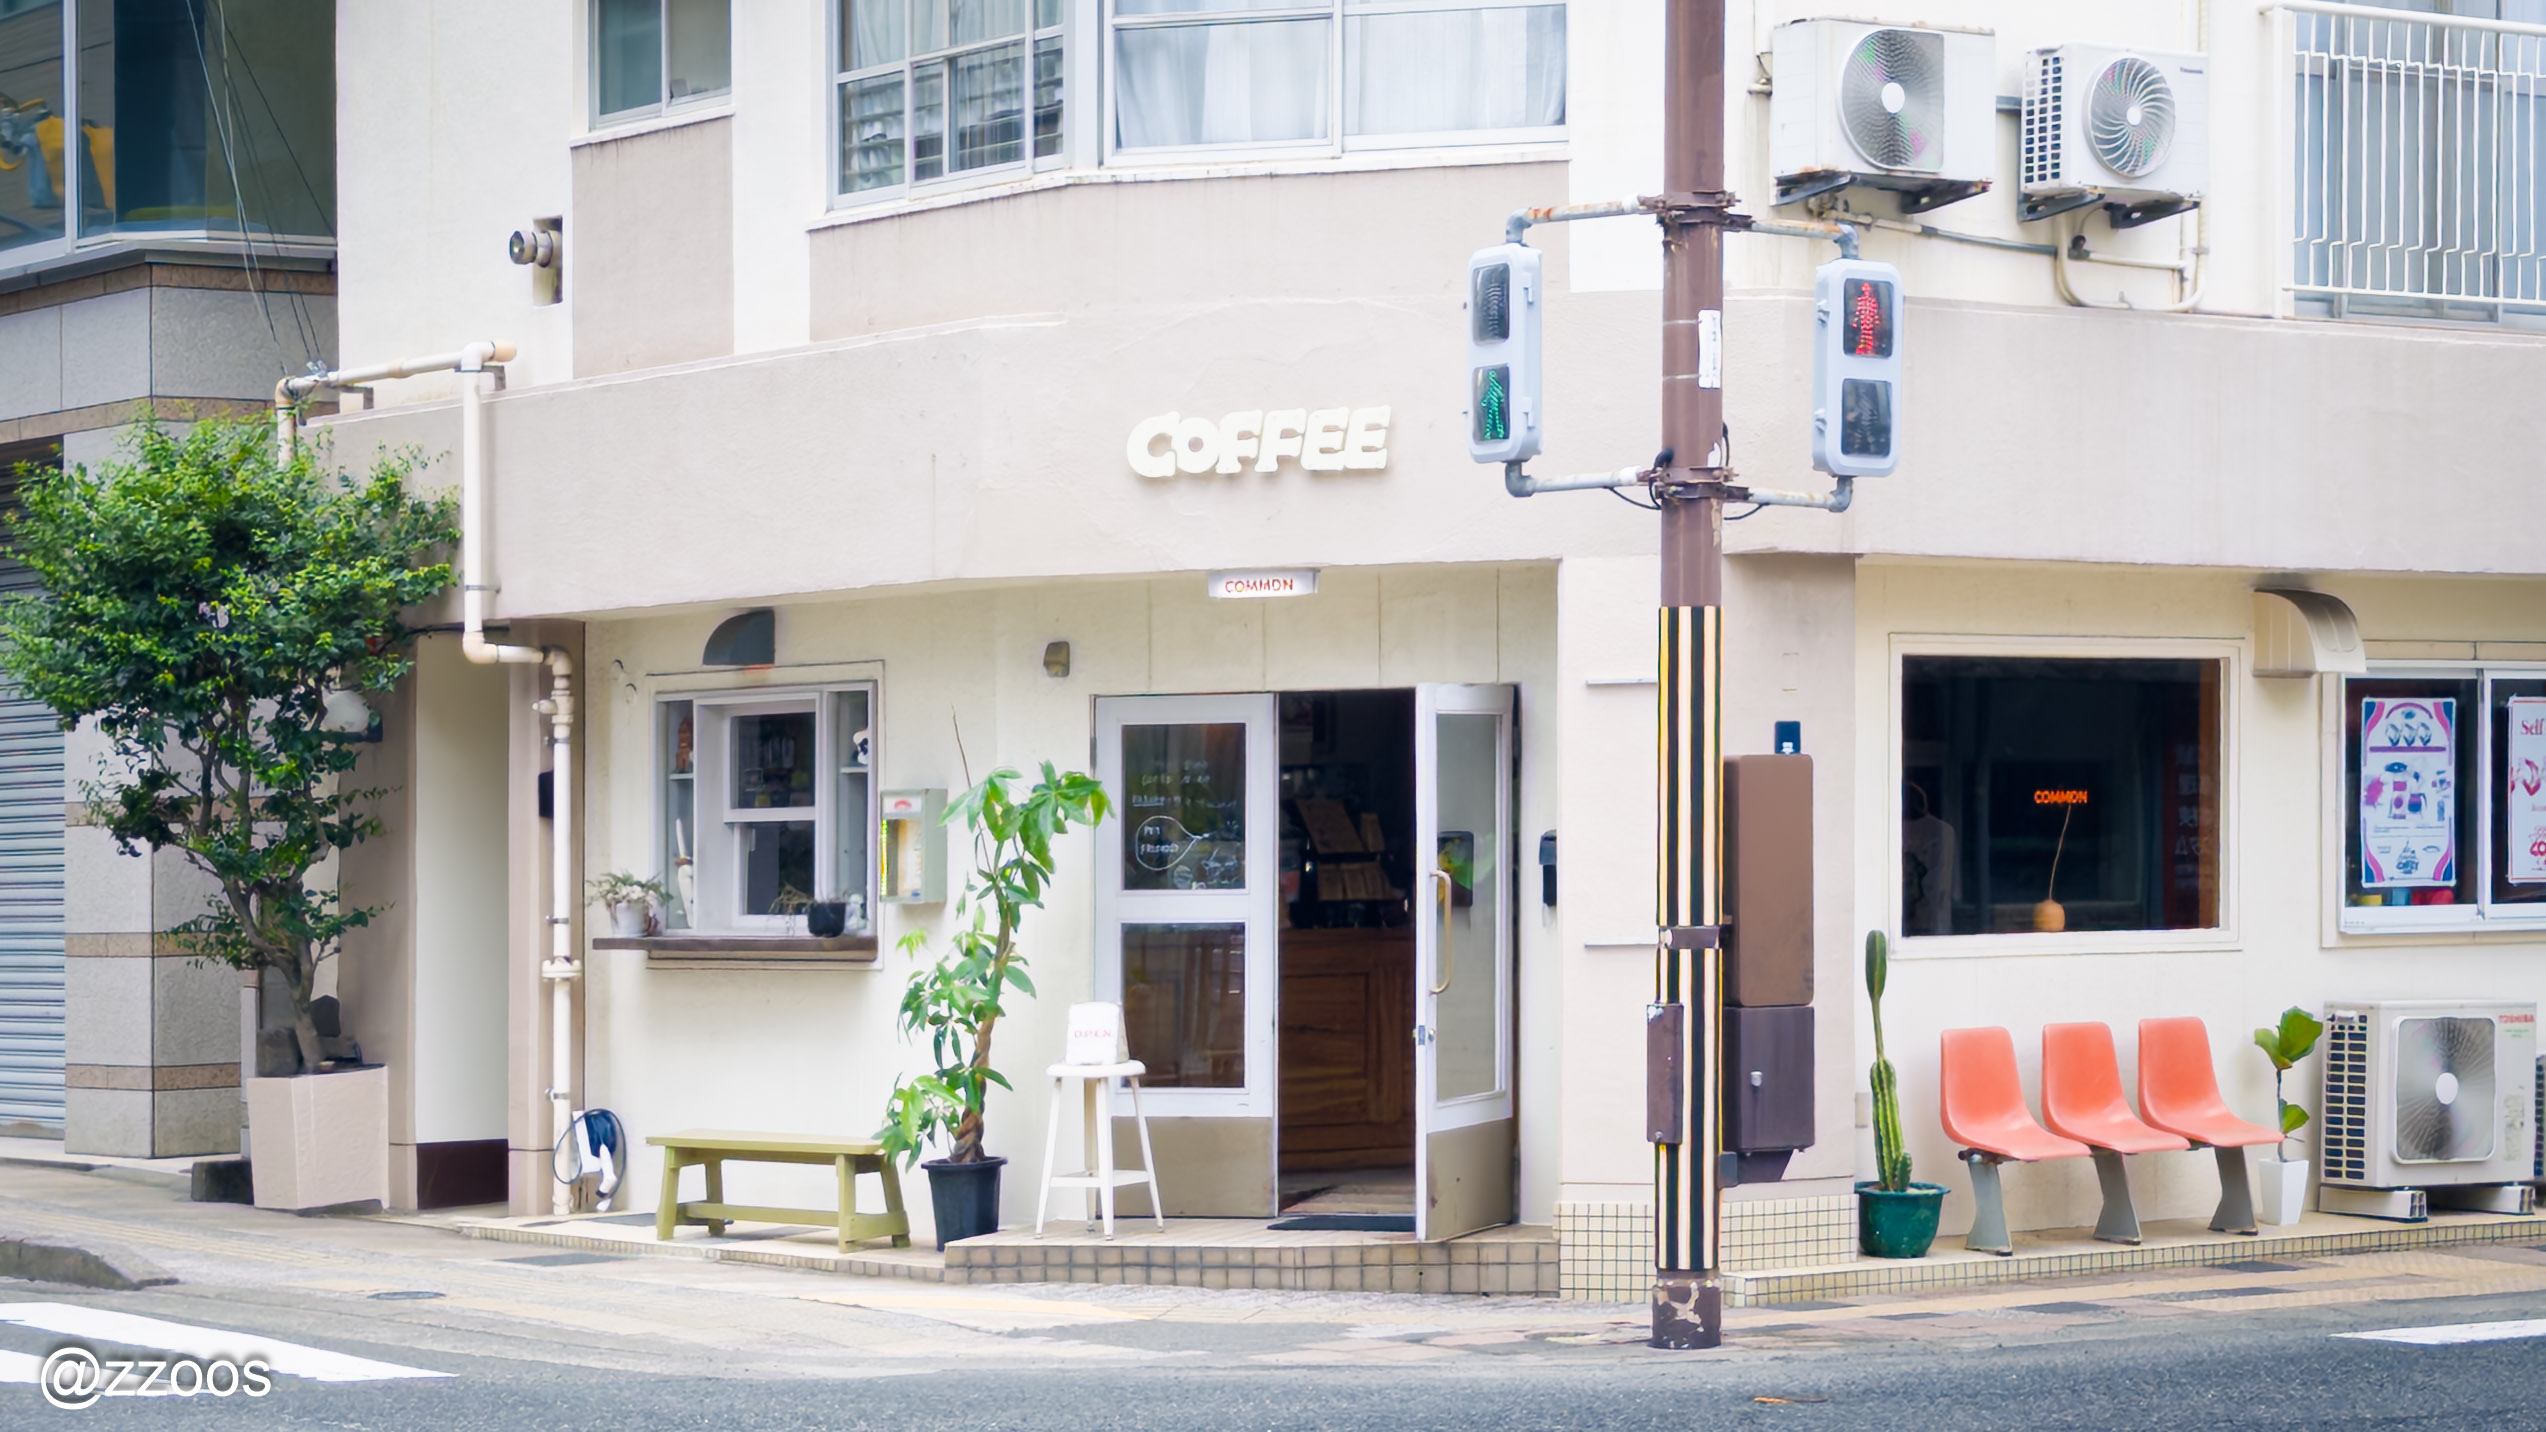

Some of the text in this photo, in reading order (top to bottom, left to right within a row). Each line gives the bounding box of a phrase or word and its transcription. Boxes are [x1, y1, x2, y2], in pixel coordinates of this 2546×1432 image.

[1126, 405, 1391, 478] COFFEE
[1225, 578, 1294, 593] COMMON
[2033, 790, 2088, 804] COMMON
